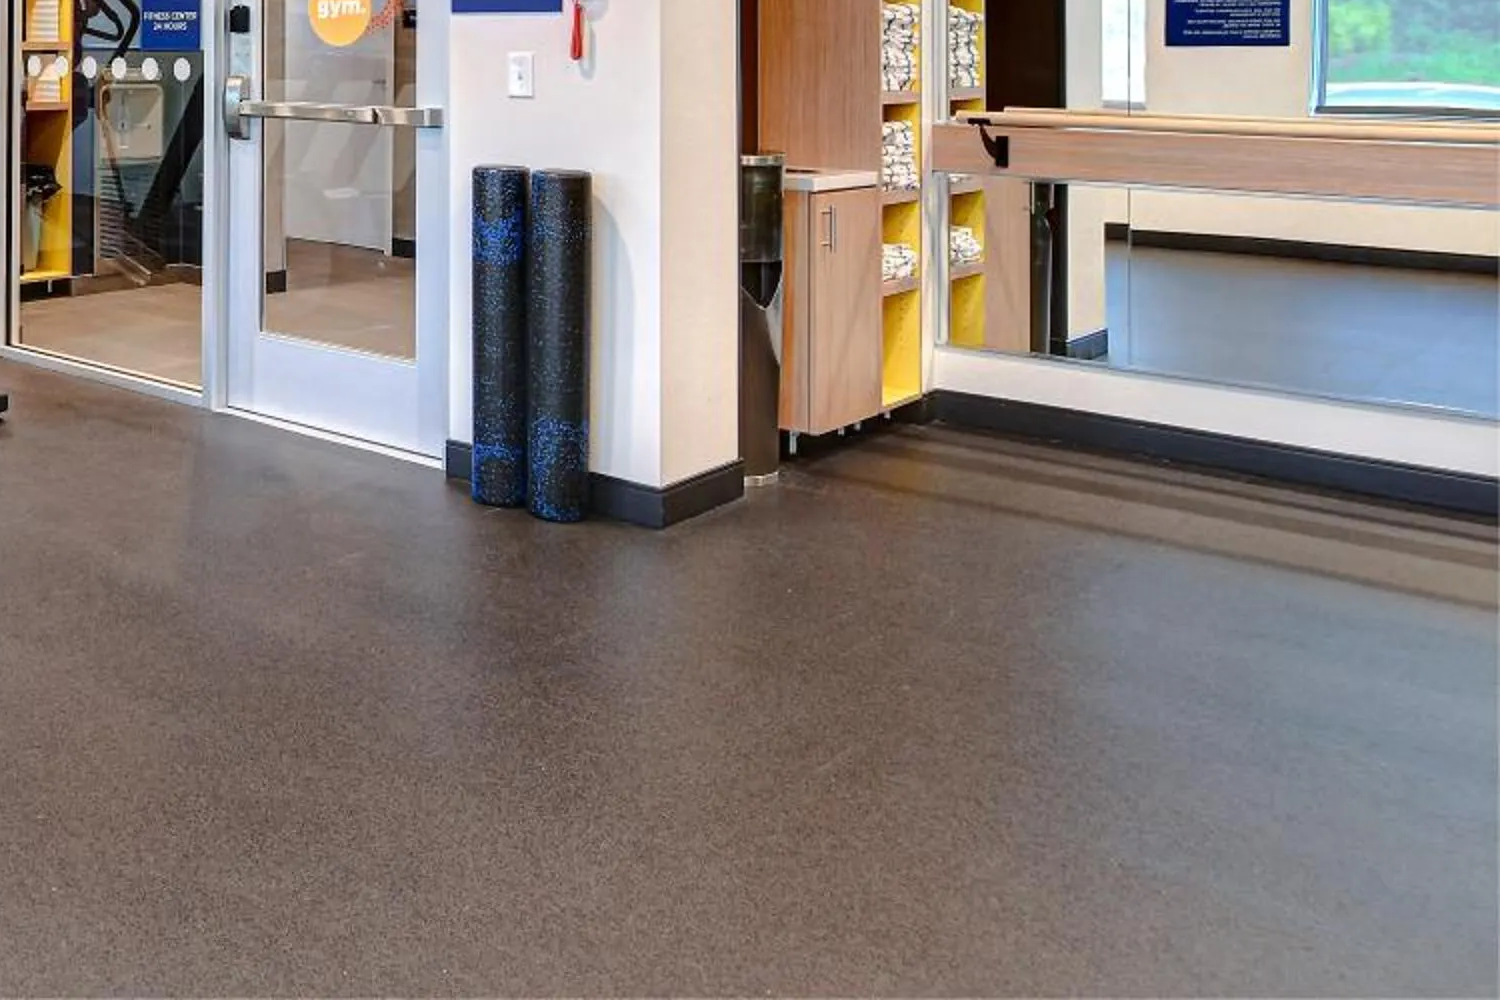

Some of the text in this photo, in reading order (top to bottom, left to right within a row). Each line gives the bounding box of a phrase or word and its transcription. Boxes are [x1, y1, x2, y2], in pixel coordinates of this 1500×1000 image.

[317, 0, 366, 19] gym.
[143, 11, 197, 21] FITNESS CENTER
[163, 21, 187, 31] HOURS
